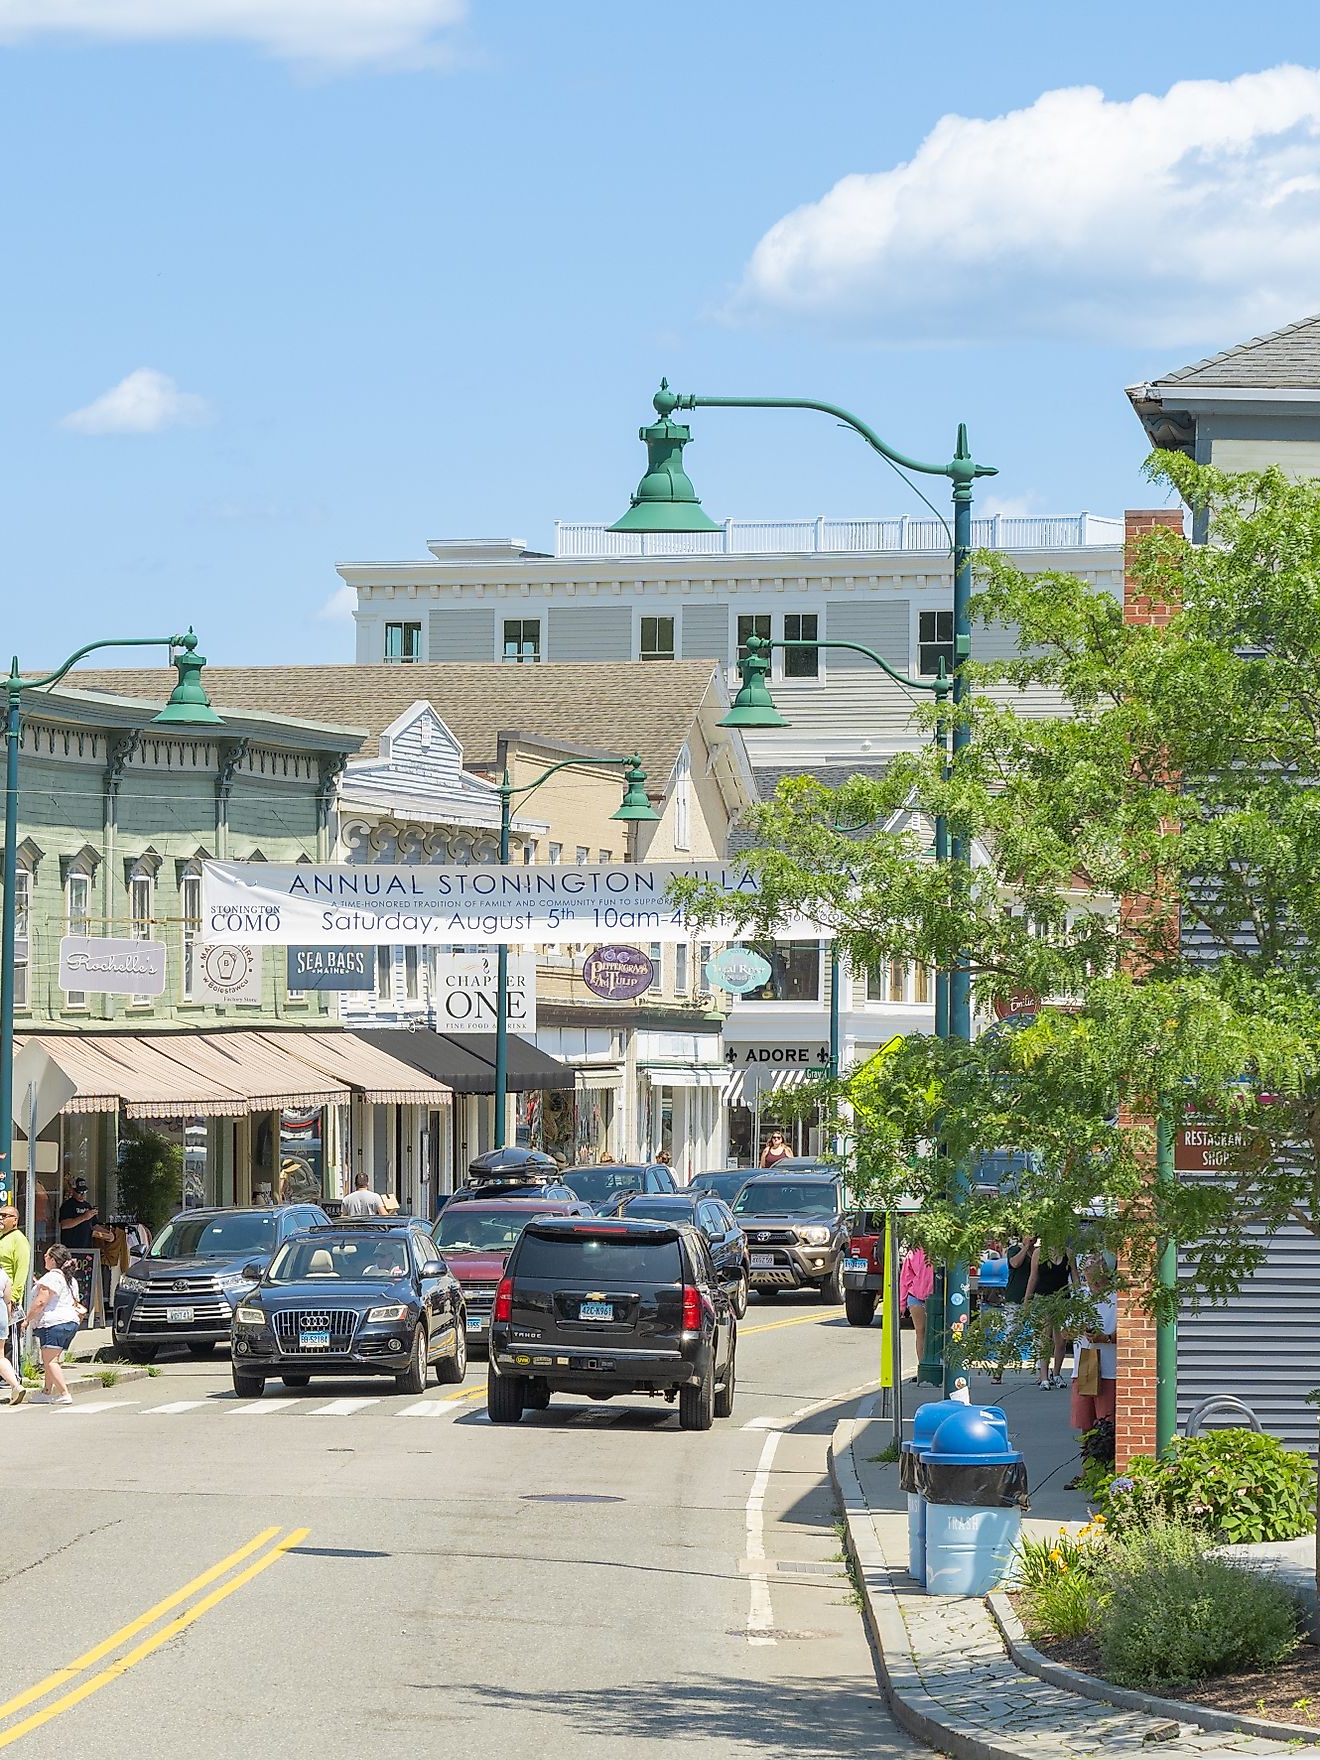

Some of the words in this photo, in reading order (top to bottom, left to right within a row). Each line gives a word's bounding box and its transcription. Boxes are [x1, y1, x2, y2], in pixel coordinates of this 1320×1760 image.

[289, 874, 424, 894] ANNUAL
[438, 871, 654, 894] STONINGTON
[670, 869, 759, 890] VILLA
[210, 905, 280, 914] STONINGTON
[341, 900, 411, 908] TIME-HONORED
[414, 900, 461, 908] TRADITION
[539, 899, 595, 907] COMMUNITY
[634, 898, 674, 906] SUPPOR
[210, 914, 280, 932] COMO
[321, 912, 439, 934] Saturday,
[447, 912, 533, 934] August
[547, 908, 575, 929] 5th
[66, 952, 158, 975] Rochelle's
[296, 951, 327, 974] SEA
[330, 951, 365, 974] BAGS
[445, 975, 526, 987] CHAPER
[445, 990, 527, 1019] ONE
[745, 1048, 810, 1062] ADORE
[947, 1516, 978, 1530] TRASH
